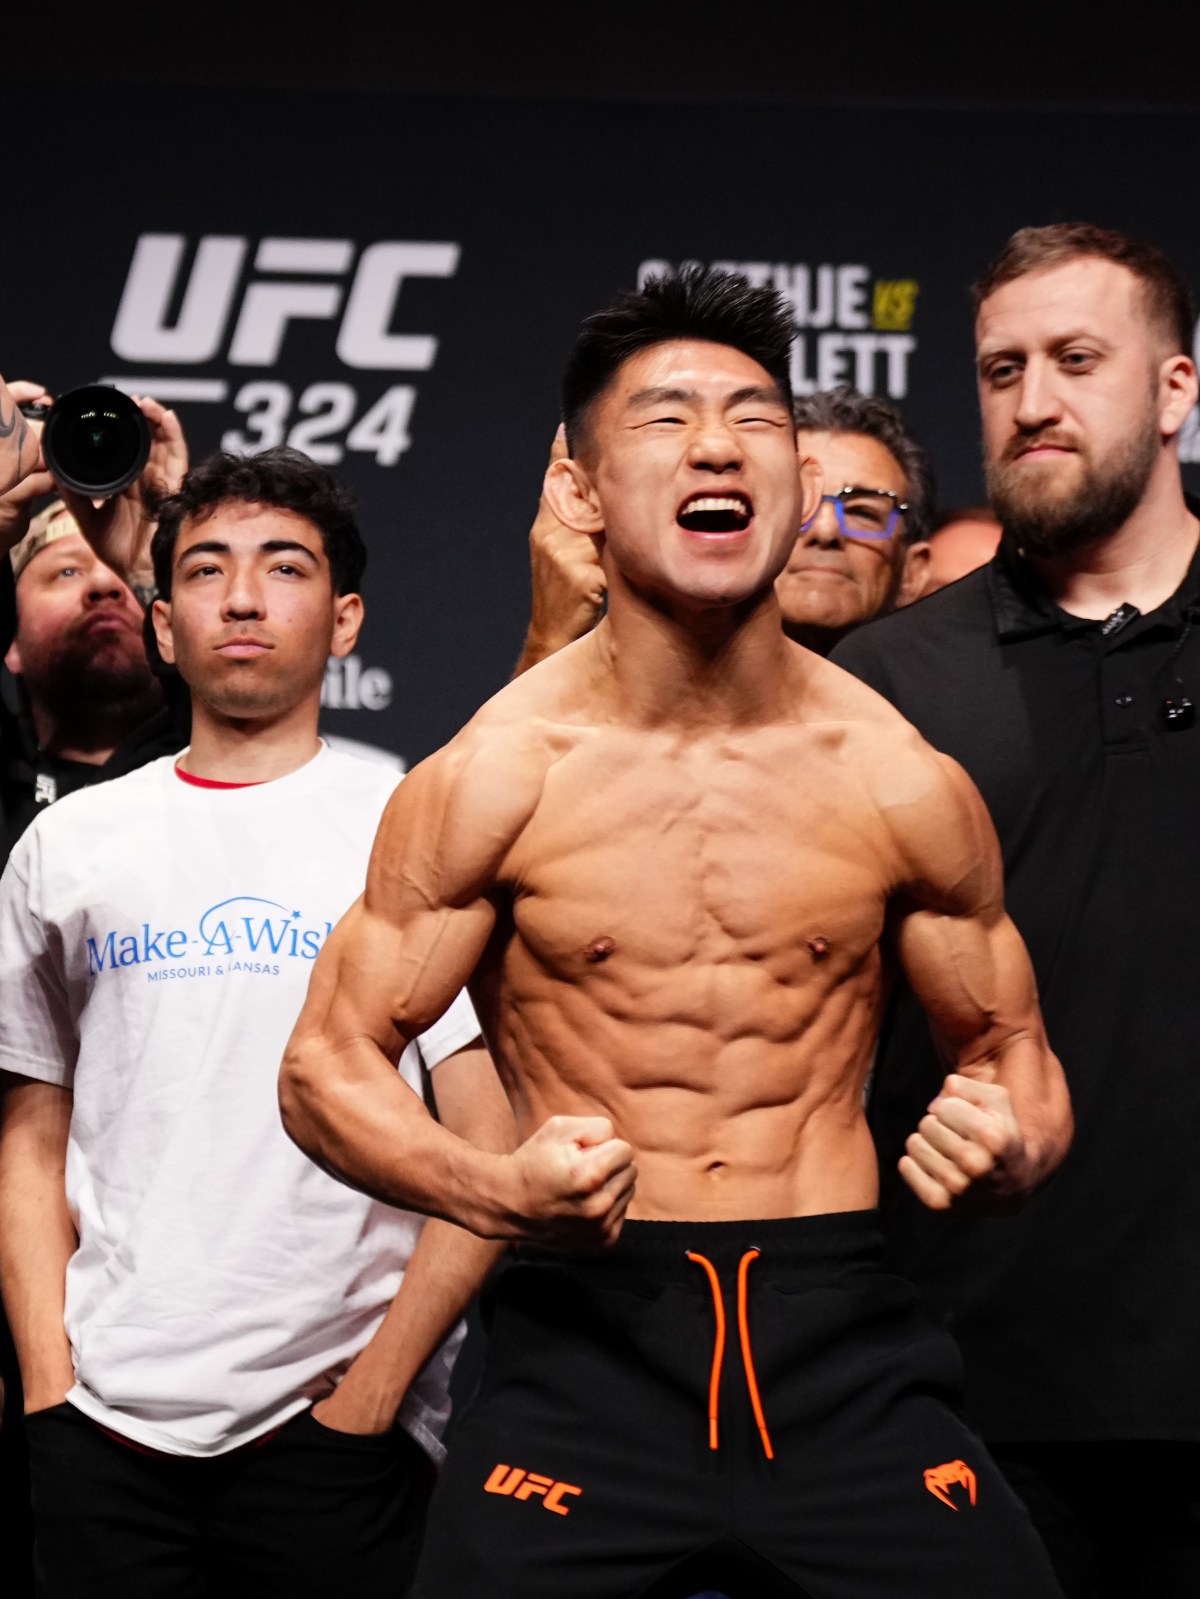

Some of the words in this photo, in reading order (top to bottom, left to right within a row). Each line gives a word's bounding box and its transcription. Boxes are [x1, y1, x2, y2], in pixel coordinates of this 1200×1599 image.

[110, 232, 461, 371] UFC
[872, 279, 919, 331] VS
[790, 333, 916, 399] LETT
[220, 378, 417, 467] 324
[147, 966, 211, 982] MISSOURI
[215, 965, 225, 976] &
[483, 1463, 583, 1516] UFC
